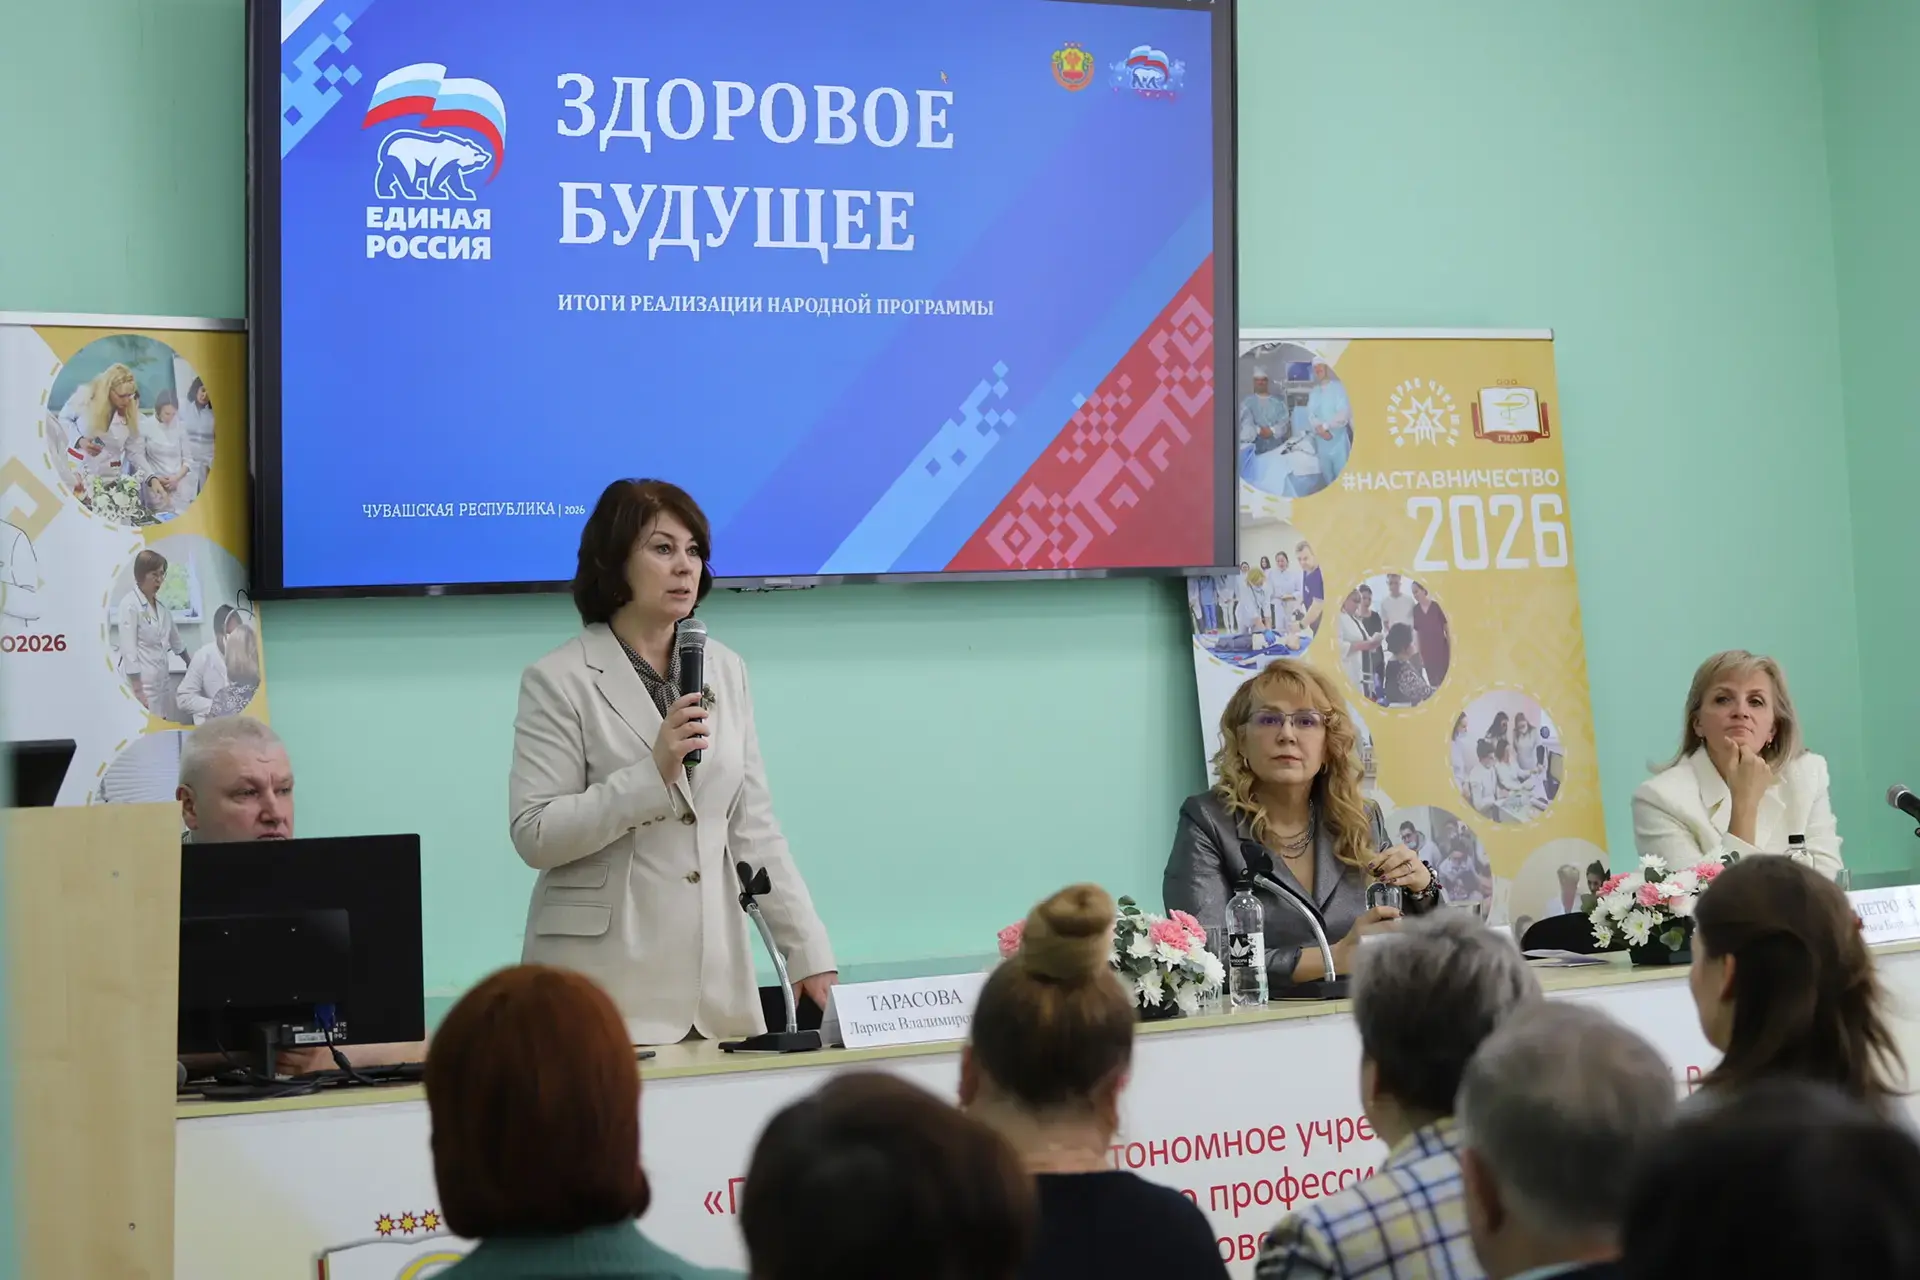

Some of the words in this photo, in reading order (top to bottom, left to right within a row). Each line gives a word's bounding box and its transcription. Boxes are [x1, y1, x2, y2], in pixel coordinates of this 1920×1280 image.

[556, 73, 954, 153] ЗДОРОВОЕ
[366, 206, 491, 231] ЕДИНАЯ
[558, 181, 916, 264] БУДУЩЕЕ
[366, 235, 491, 260] РОССИЯ
[558, 293, 626, 312] ИТОГИ
[630, 294, 764, 316] РЕАЛИЗАЦИИ
[768, 293, 871, 317] НАРОДНОЙ
[876, 298, 995, 316] ПРОГРАММЫ
[1341, 468, 1560, 491] #НАСТАВНИЧЕСТВО
[362, 503, 453, 518] ЧУВАШСКАЯ
[458, 502, 556, 517] РЕСПУБЛИКА
[564, 504, 586, 515] 2026
[1406, 493, 1568, 572] 2026
[866, 988, 964, 1012] ТАРАСОВА
[849, 1021, 896, 1037] Лариса
